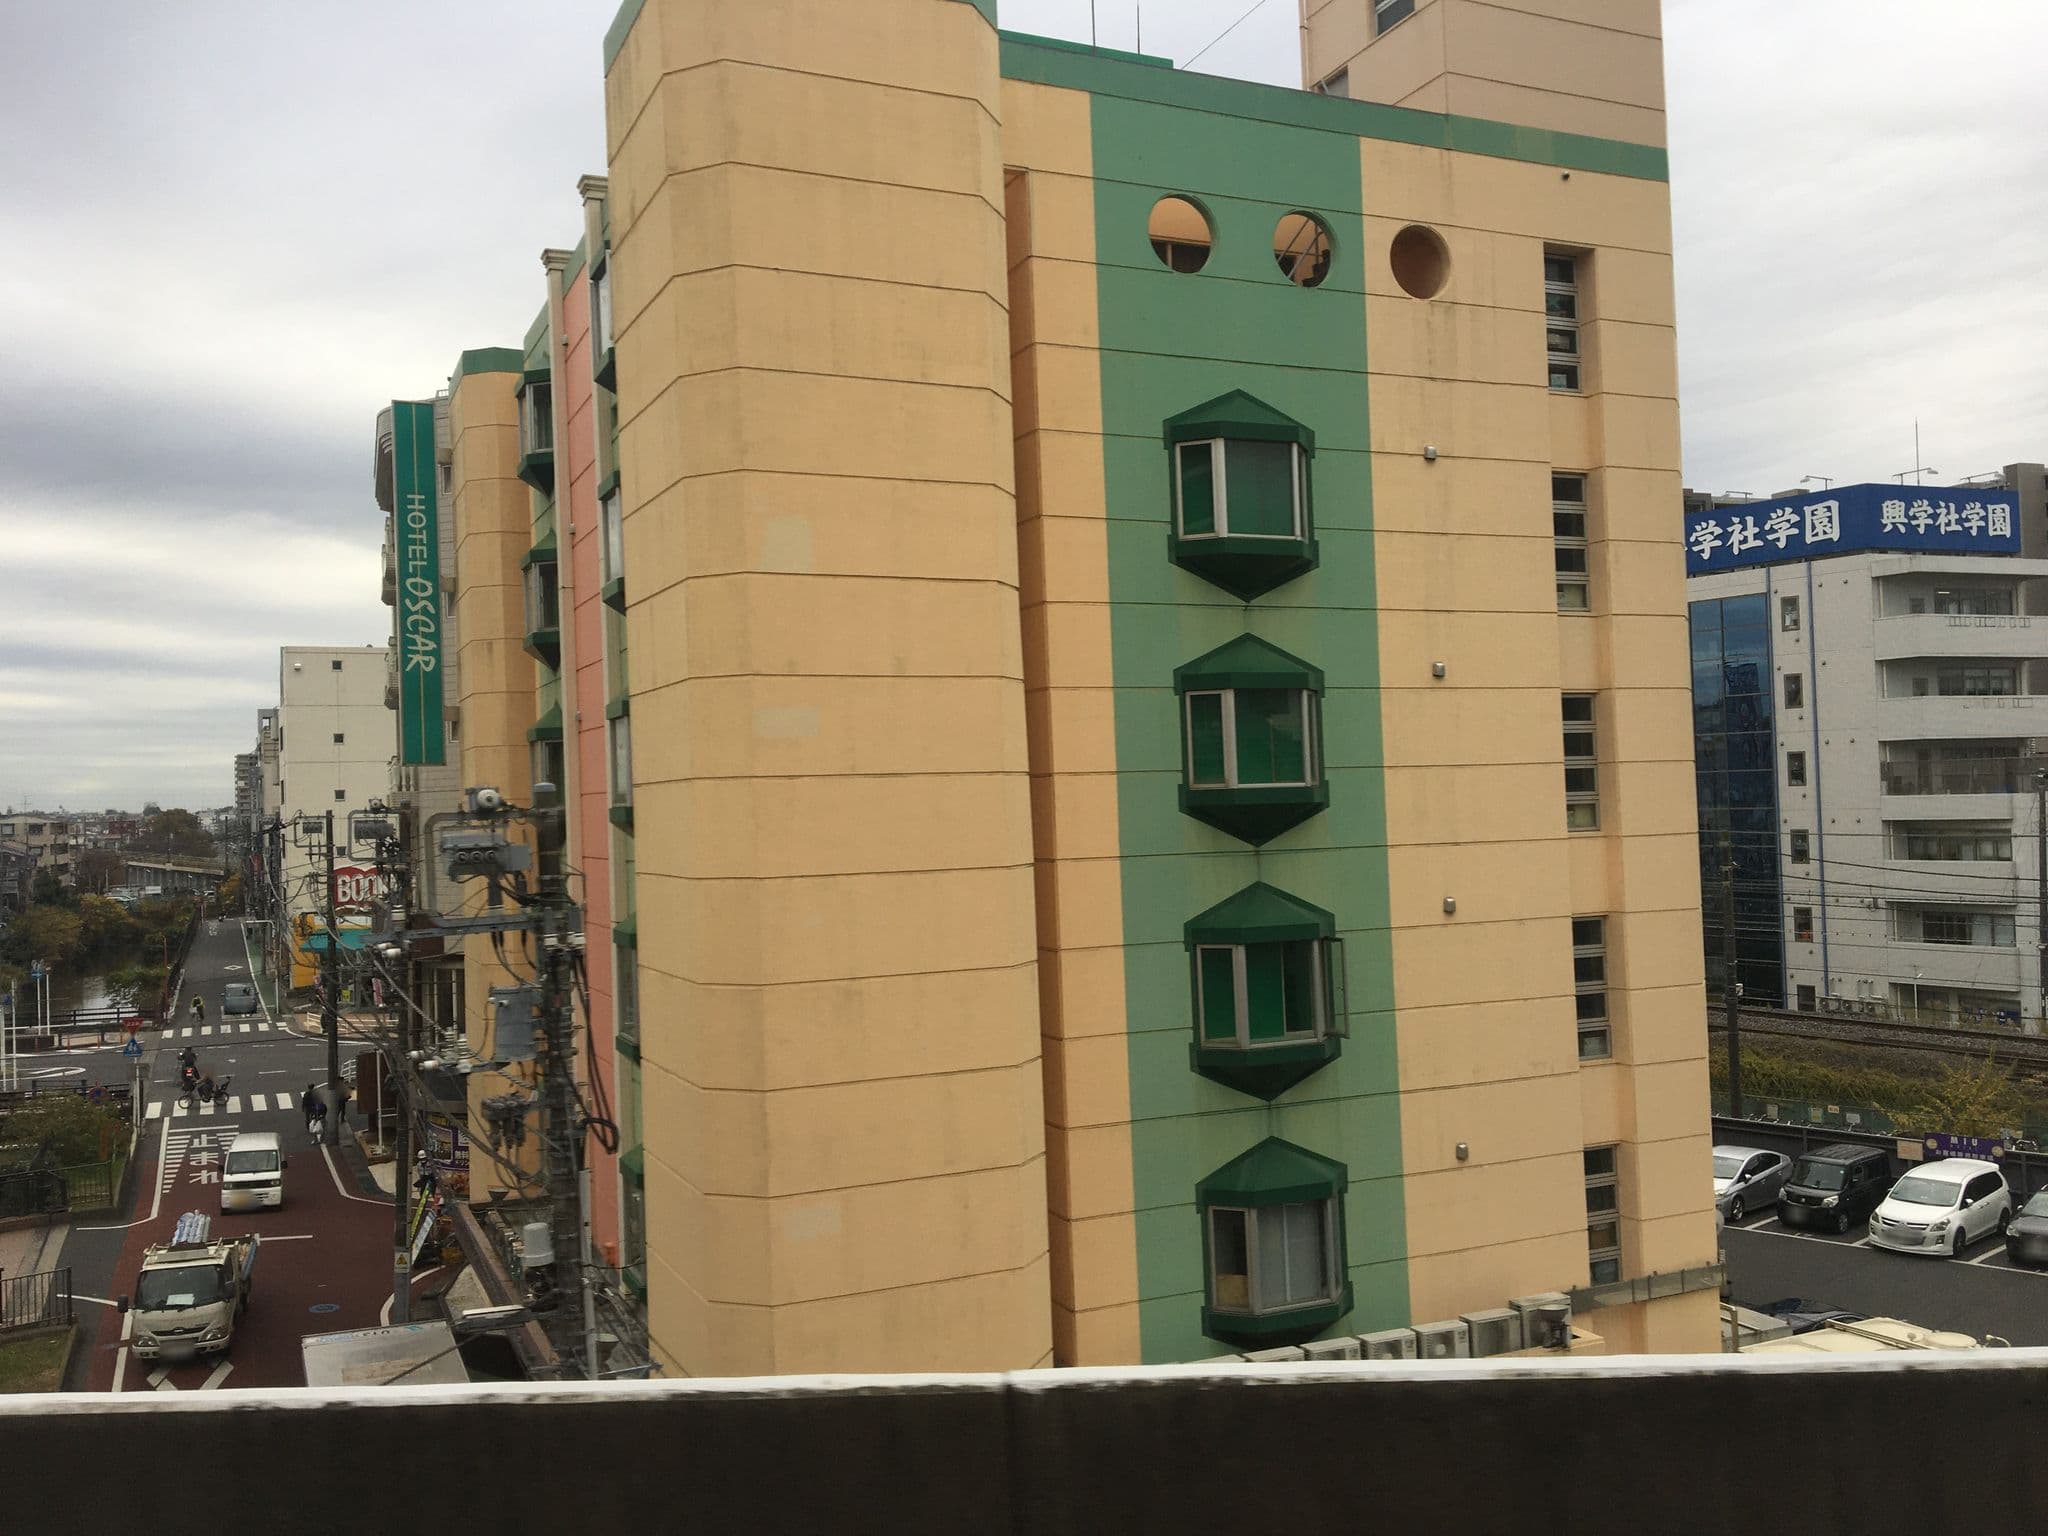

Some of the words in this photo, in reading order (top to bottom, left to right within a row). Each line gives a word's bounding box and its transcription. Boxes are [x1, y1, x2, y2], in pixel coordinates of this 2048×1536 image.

[406, 494, 428, 573] HOTEL
[1685, 499, 1840, 560] 学社学園
[1880, 499, 2012, 538] 興学社学園
[405, 577, 437, 672] OSCAR
[189, 1134, 219, 1185] 止まれ
